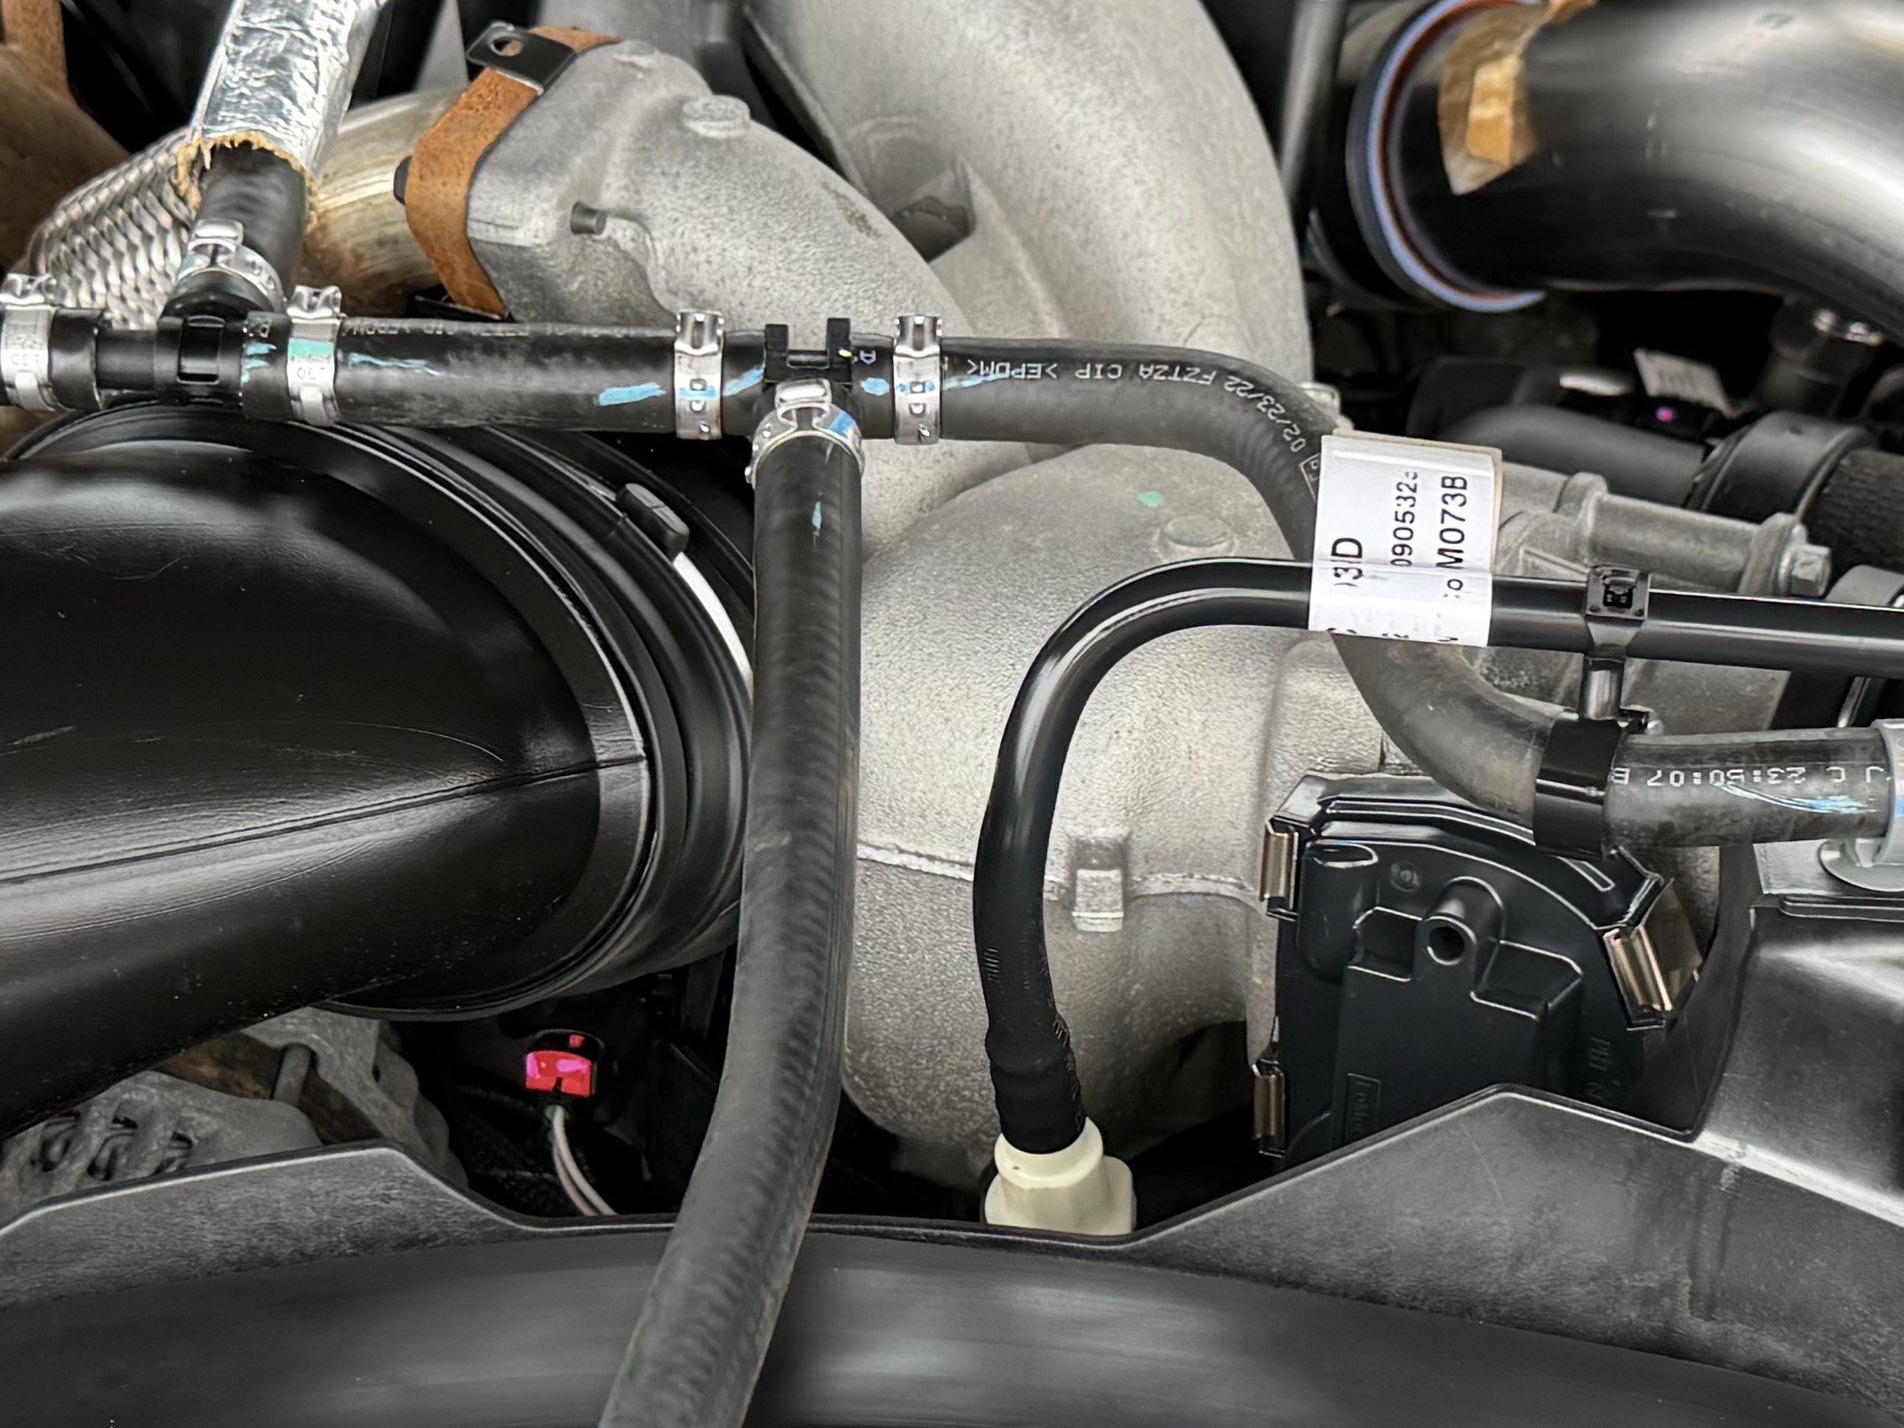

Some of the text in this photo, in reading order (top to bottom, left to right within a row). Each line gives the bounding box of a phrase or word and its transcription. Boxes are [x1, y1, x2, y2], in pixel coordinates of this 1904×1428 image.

[966, 358, 1058, 380] >EPDM<
[1074, 362, 1122, 380] CIP
[1138, 362, 1217, 385] FZTZA
[1223, 374, 1308, 453] 02/23/22
[1645, 766, 1806, 788] 23:50:07
[1824, 766, 1847, 783] C
